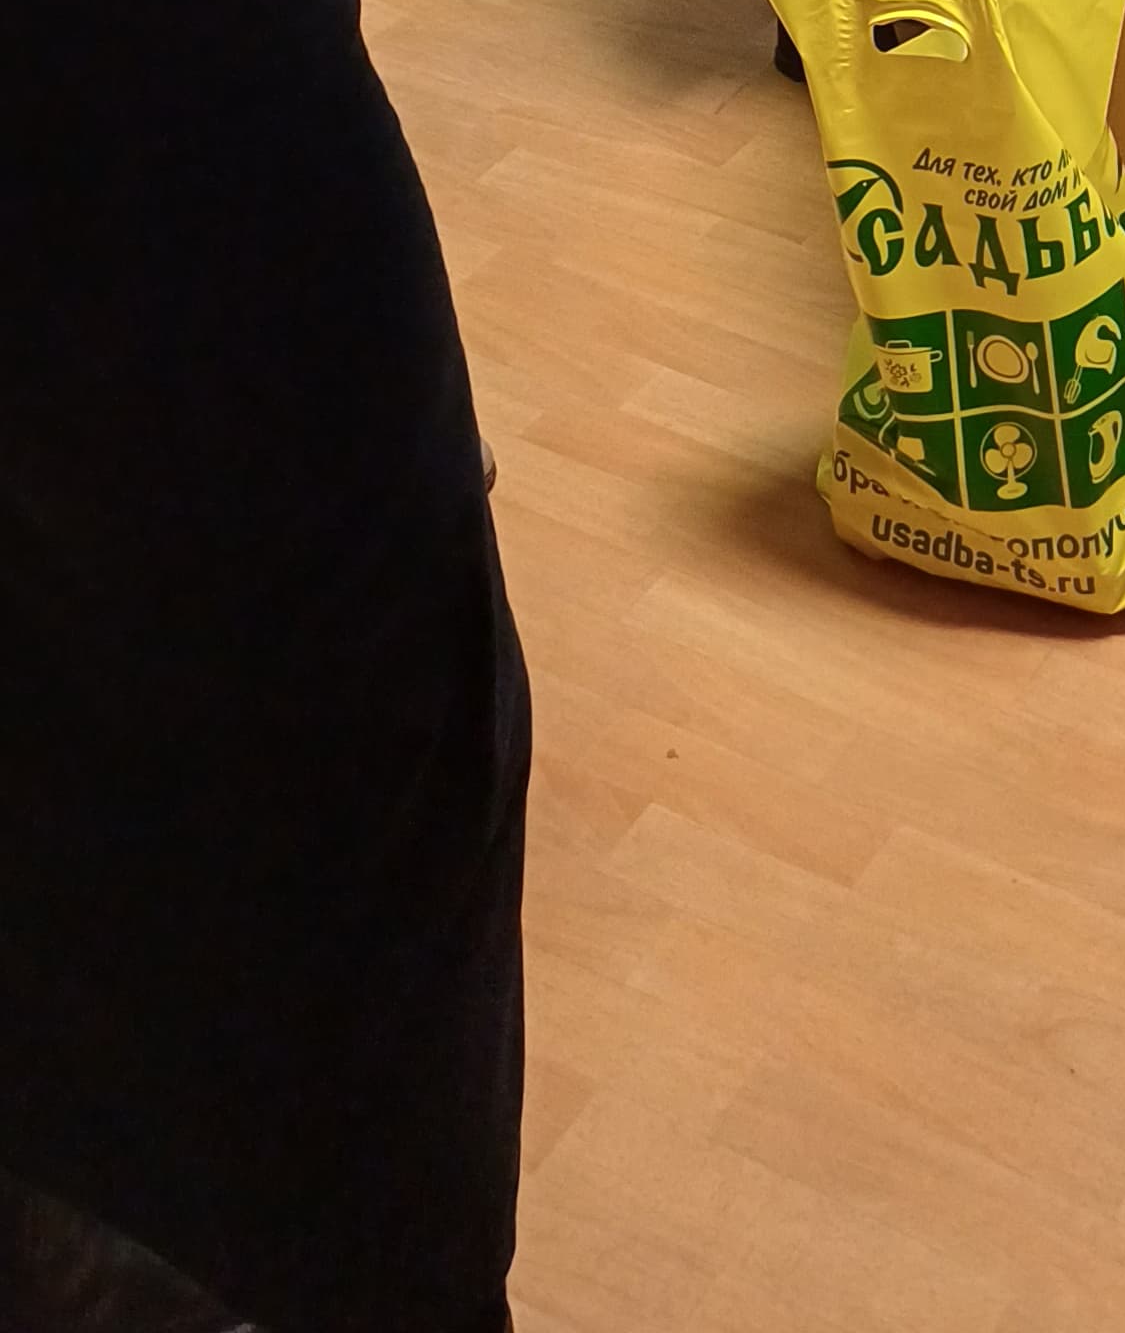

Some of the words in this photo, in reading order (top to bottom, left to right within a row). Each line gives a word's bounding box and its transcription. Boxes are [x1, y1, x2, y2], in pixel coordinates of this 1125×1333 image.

[912, 147, 956, 177] Для
[1011, 160, 1053, 186] кто
[964, 188, 1018, 213] свой
[1022, 176, 1068, 211] дом
[872, 514, 1097, 596] usadba-ts.ru
